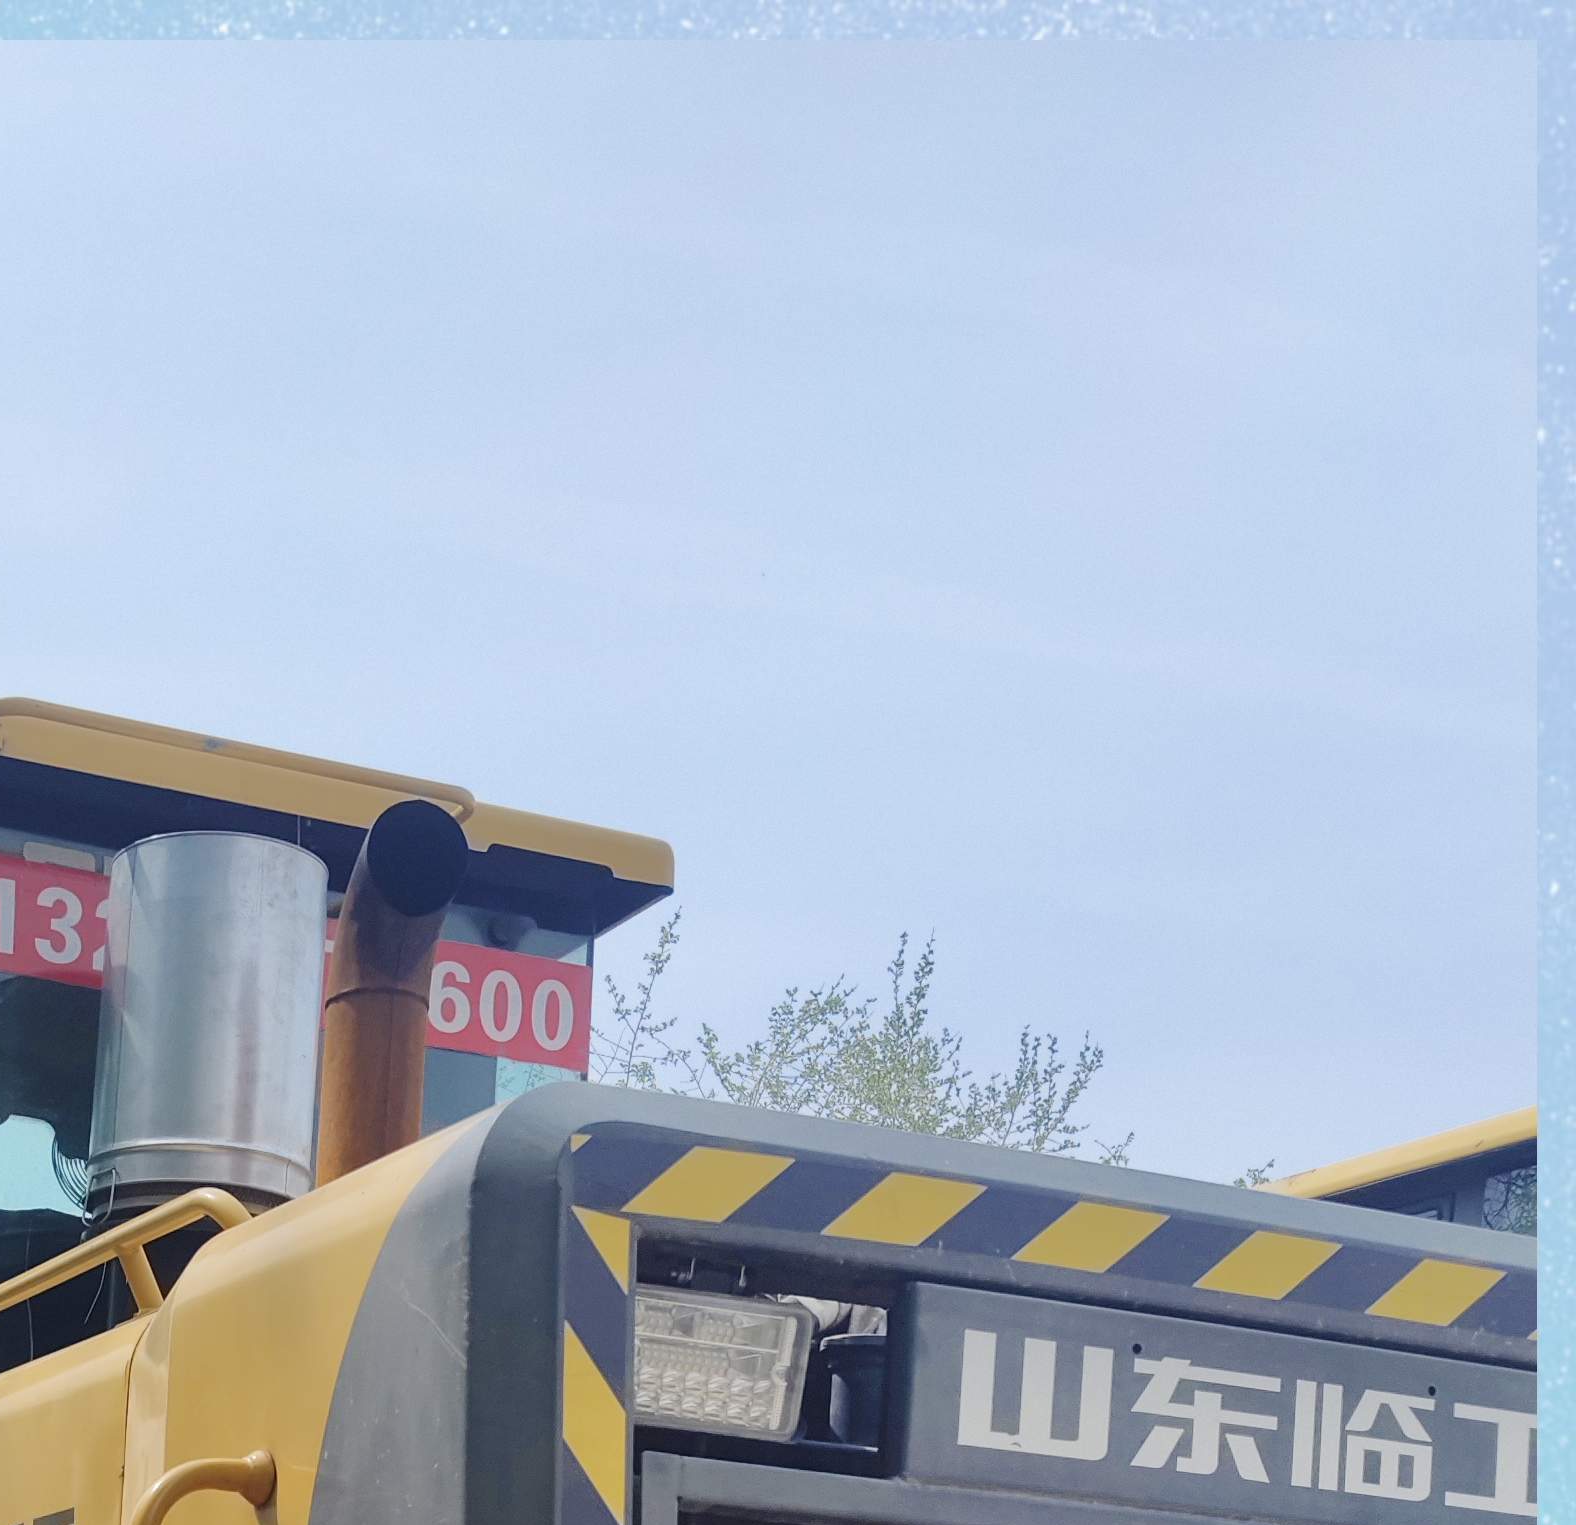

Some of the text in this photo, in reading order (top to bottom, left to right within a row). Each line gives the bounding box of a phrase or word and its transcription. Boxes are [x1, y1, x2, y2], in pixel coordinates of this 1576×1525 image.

[427, 960, 574, 1051] 600
[956, 1328, 1538, 1518] 山东临工
